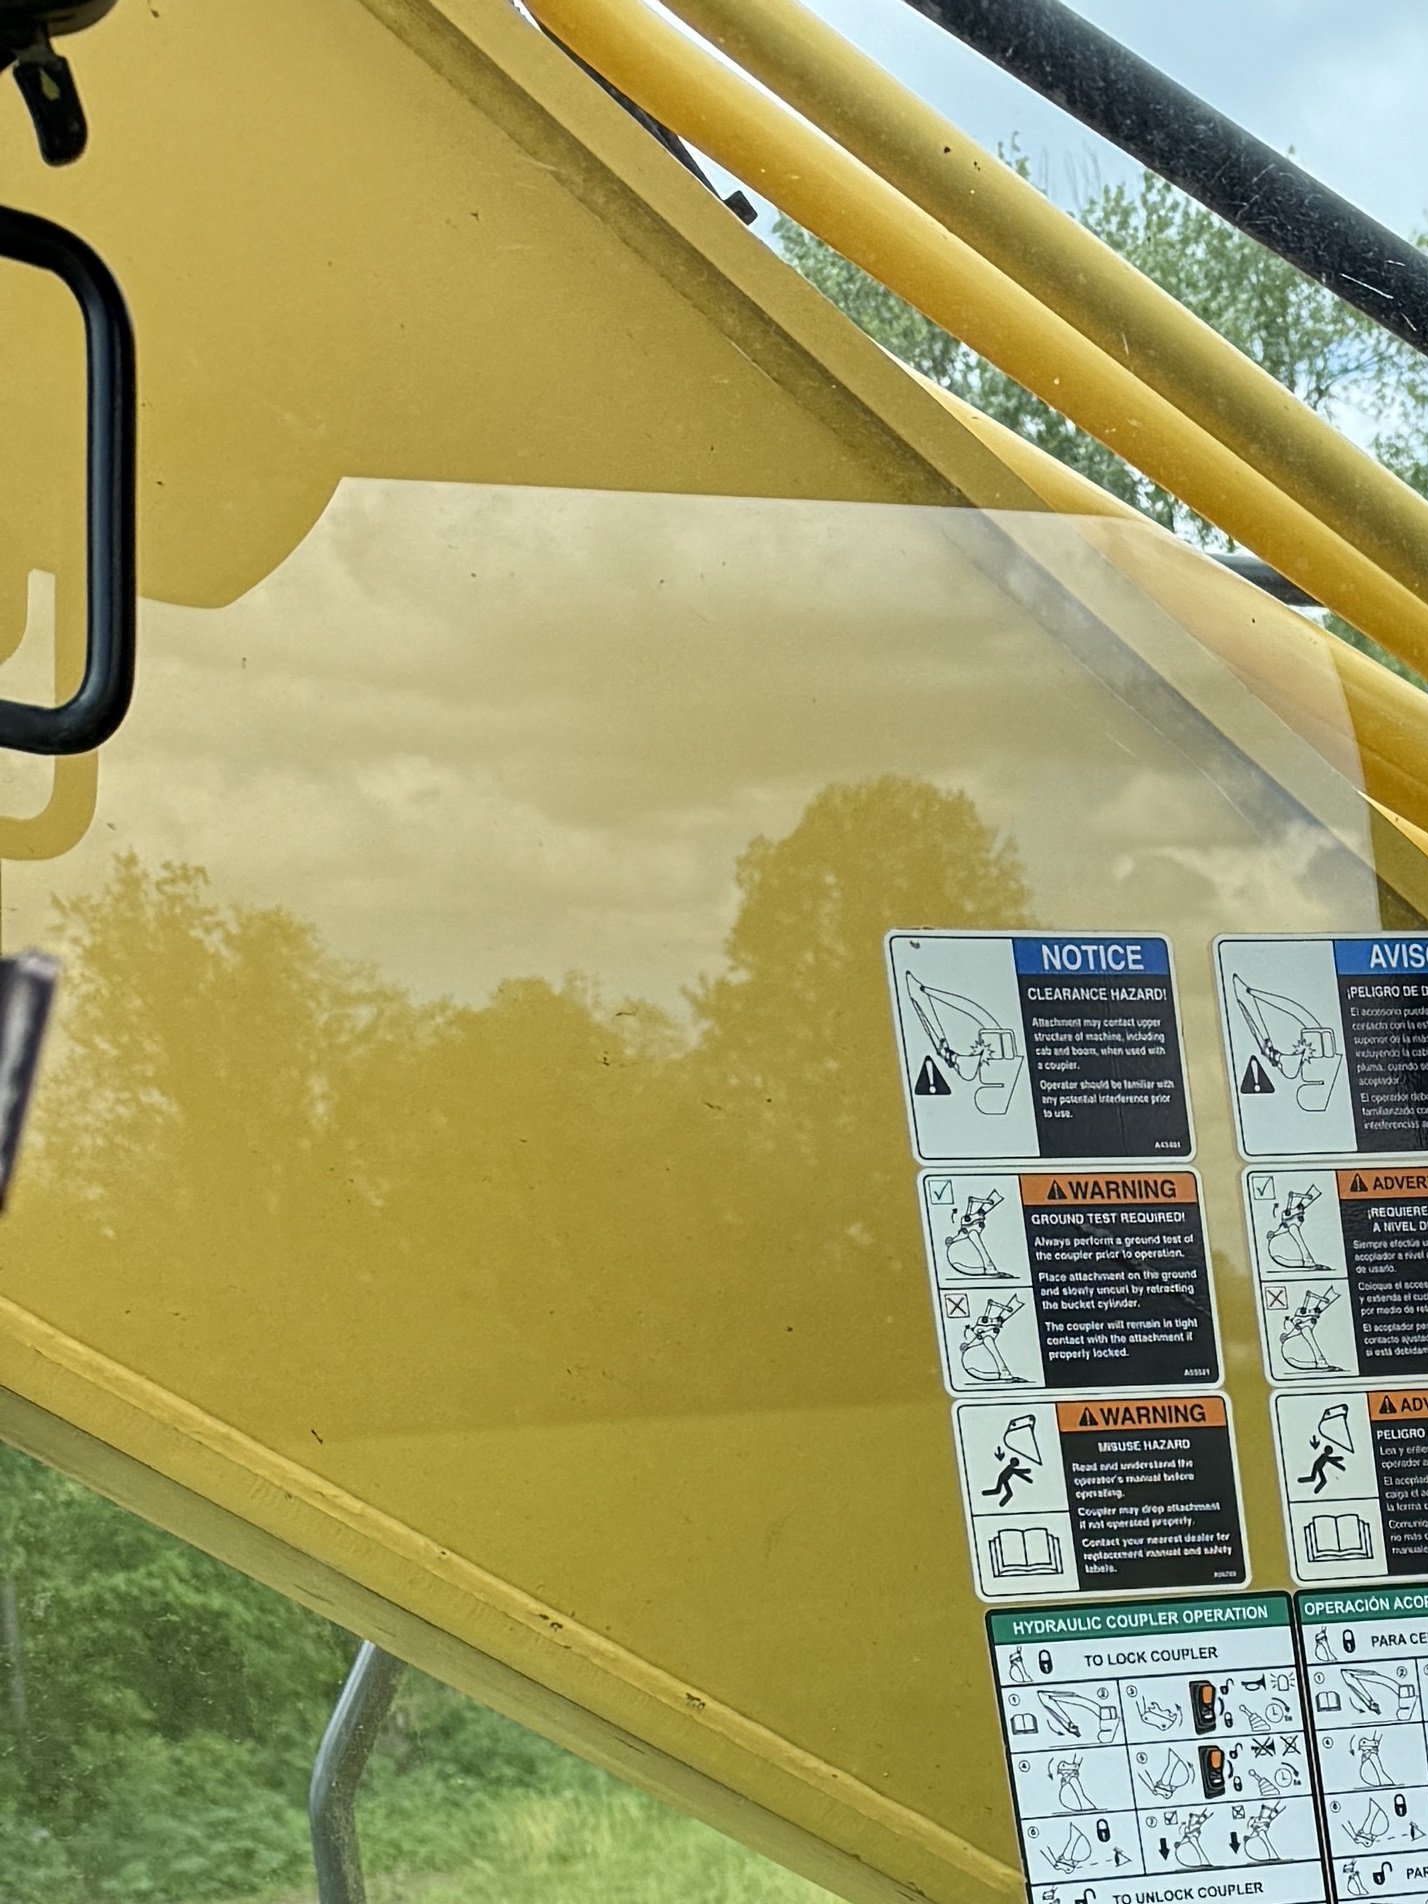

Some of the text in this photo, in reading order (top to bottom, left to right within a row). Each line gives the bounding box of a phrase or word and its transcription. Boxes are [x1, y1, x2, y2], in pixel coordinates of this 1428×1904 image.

[1041, 945, 1144, 970] NOTICE
[1028, 988, 1167, 1000] CLEARANCE HAZARD!
[1347, 986, 1399, 999] ¡PELIGRO
[1403, 986, 1418, 996] DE
[1068, 1179, 1176, 1199] WARNING
[1031, 1212, 1185, 1224] GROUND TEST REQUIRED!
[1367, 1206, 1428, 1220] ¡REQUIERE
[1373, 1223, 1381, 1232] A
[1384, 1222, 1416, 1232] NIVEL
[1034, 1237, 1070, 1248] Always
[1074, 1237, 1114, 1247] perform
[1124, 1235, 1160, 1247] ground
[1163, 1235, 1181, 1243] test
[1184, 1234, 1193, 1243] of
[1036, 1249, 1185, 1261] the coupler prior to operation.
[1100, 1404, 1206, 1425] WARNING
[1377, 1428, 1425, 1440] PELIGRO
[1098, 1439, 1191, 1452] MISUSE HAZARD
[1305, 1596, 1390, 1615] OPERACIÓN
[1013, 1605, 1268, 1635] HYDRAULIC COUPLER OPERATION
[1371, 1634, 1405, 1647] PARA
[1084, 1647, 1217, 1666] TO LOCK COUPLER
[1135, 1889, 1194, 1904] UNLOCK
[1198, 1882, 1264, 1899] COUPLER
